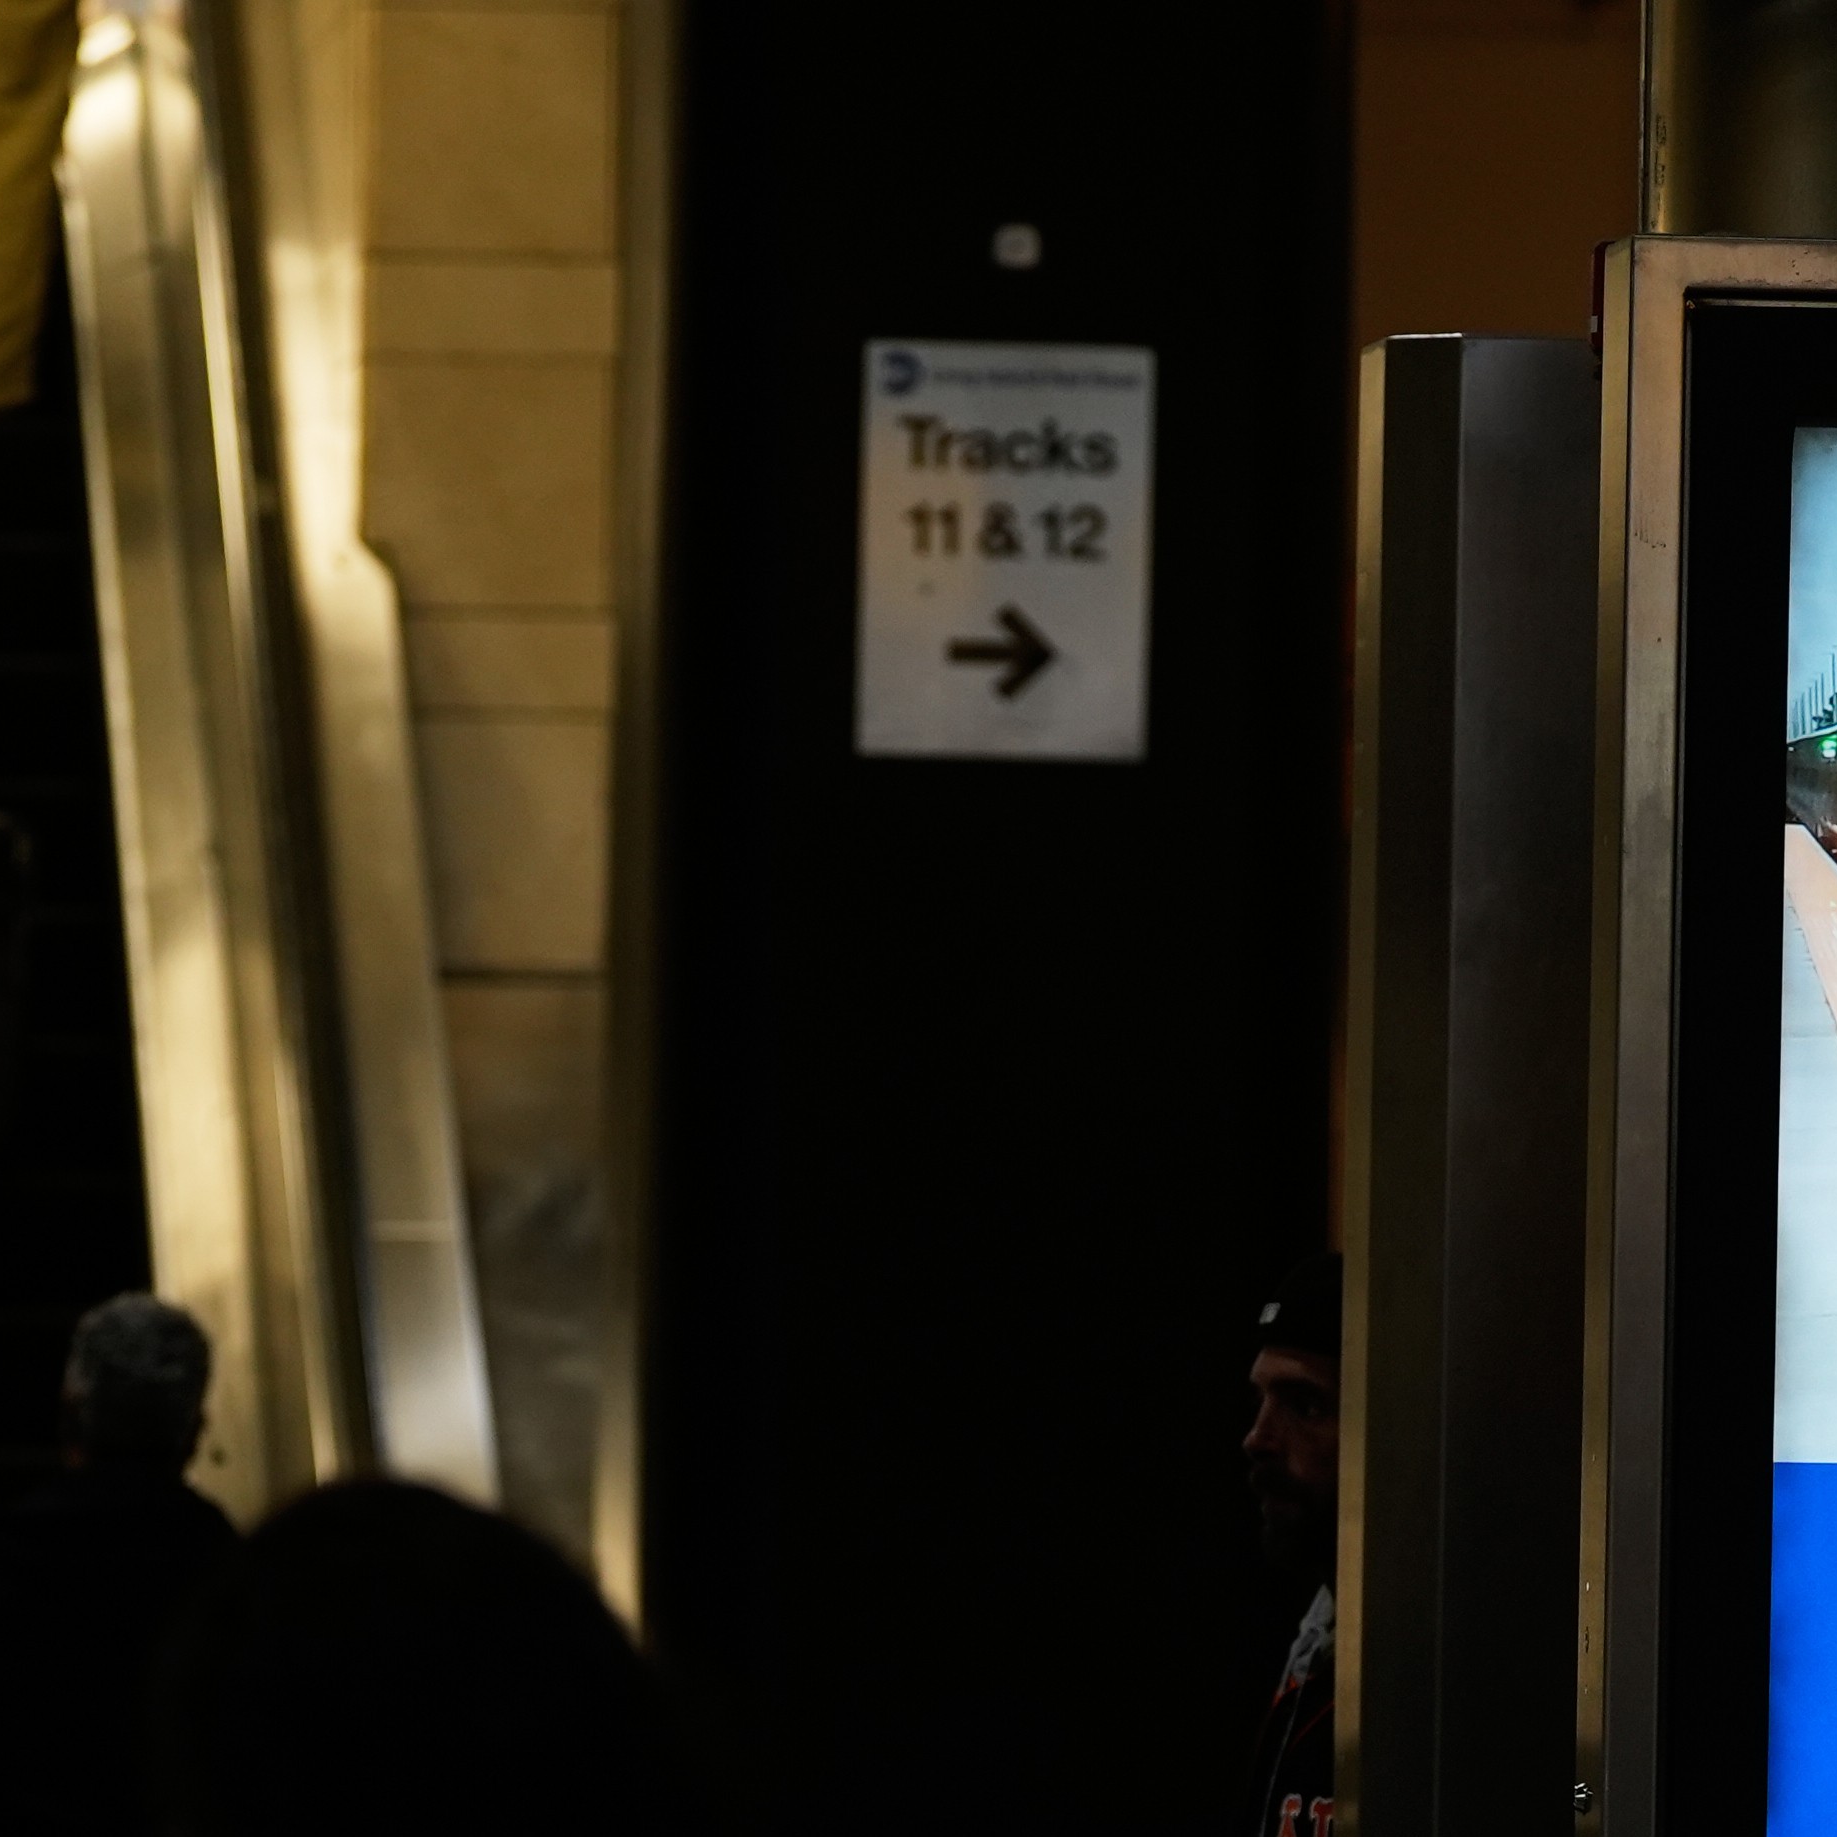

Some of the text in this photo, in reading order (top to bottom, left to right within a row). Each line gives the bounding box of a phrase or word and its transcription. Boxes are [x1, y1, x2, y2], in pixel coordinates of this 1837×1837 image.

[901, 415, 1117, 474] Tracks
[911, 503, 1105, 560] 11 & 12
